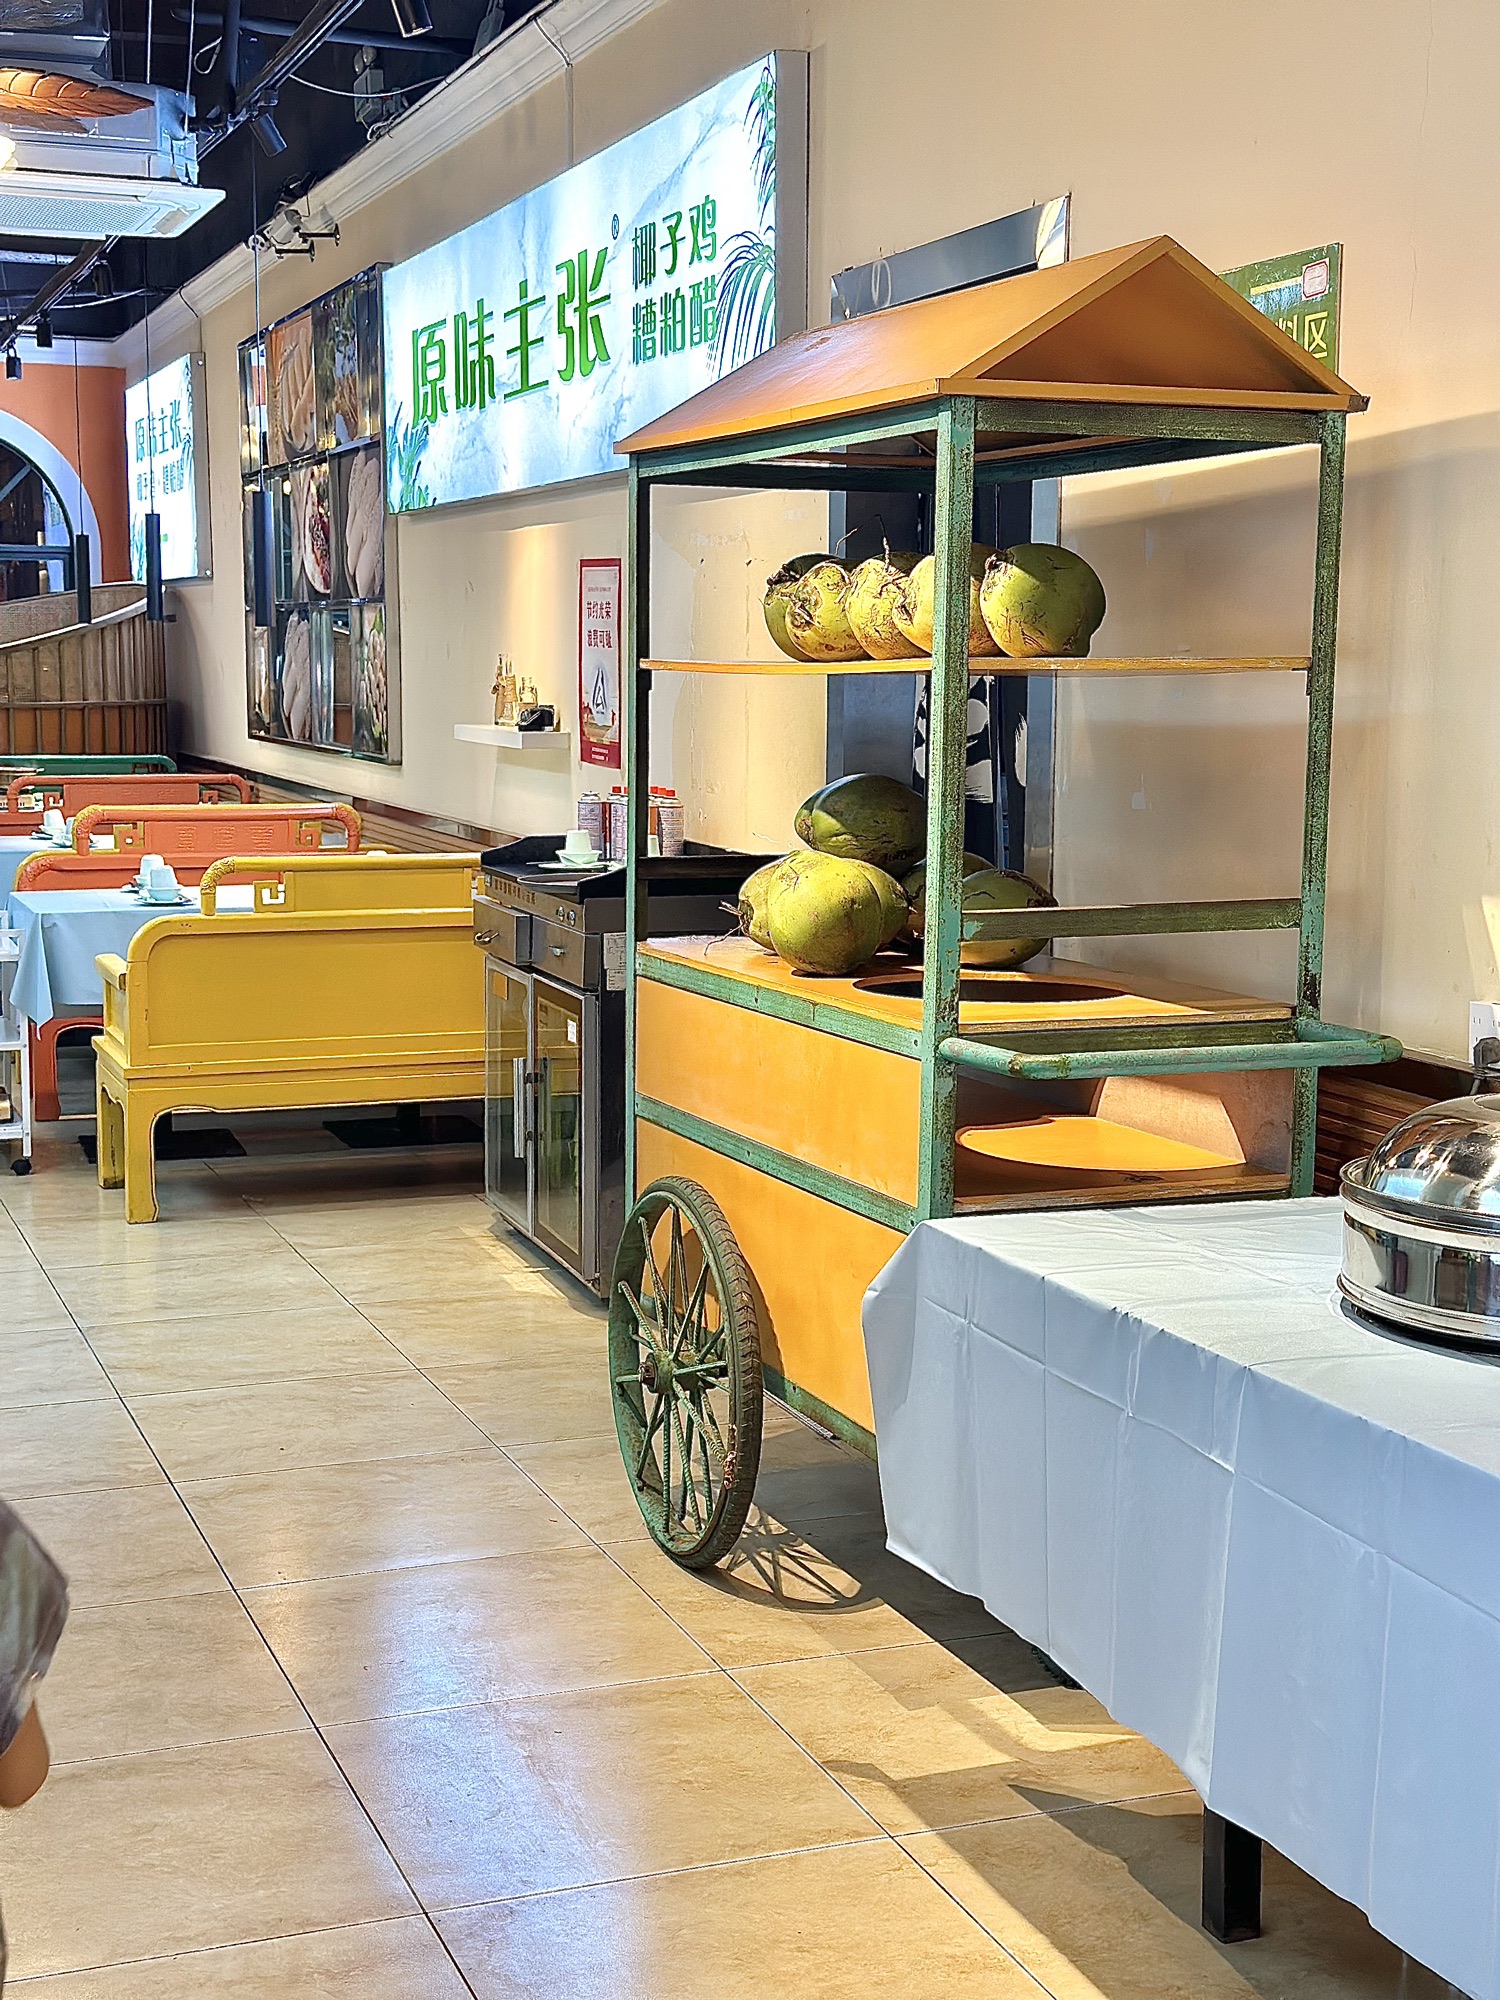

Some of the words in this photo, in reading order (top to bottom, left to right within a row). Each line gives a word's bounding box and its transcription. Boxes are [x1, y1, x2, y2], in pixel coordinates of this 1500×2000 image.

[632, 194, 717, 289] 椰子鸡
[411, 247, 612, 428] 原味主张
[632, 274, 717, 365] 糟粕醋
[135, 399, 183, 463] 原味主张
[586, 601, 611, 619] 节约光荣
[587, 629, 612, 649] 浪费可耻
